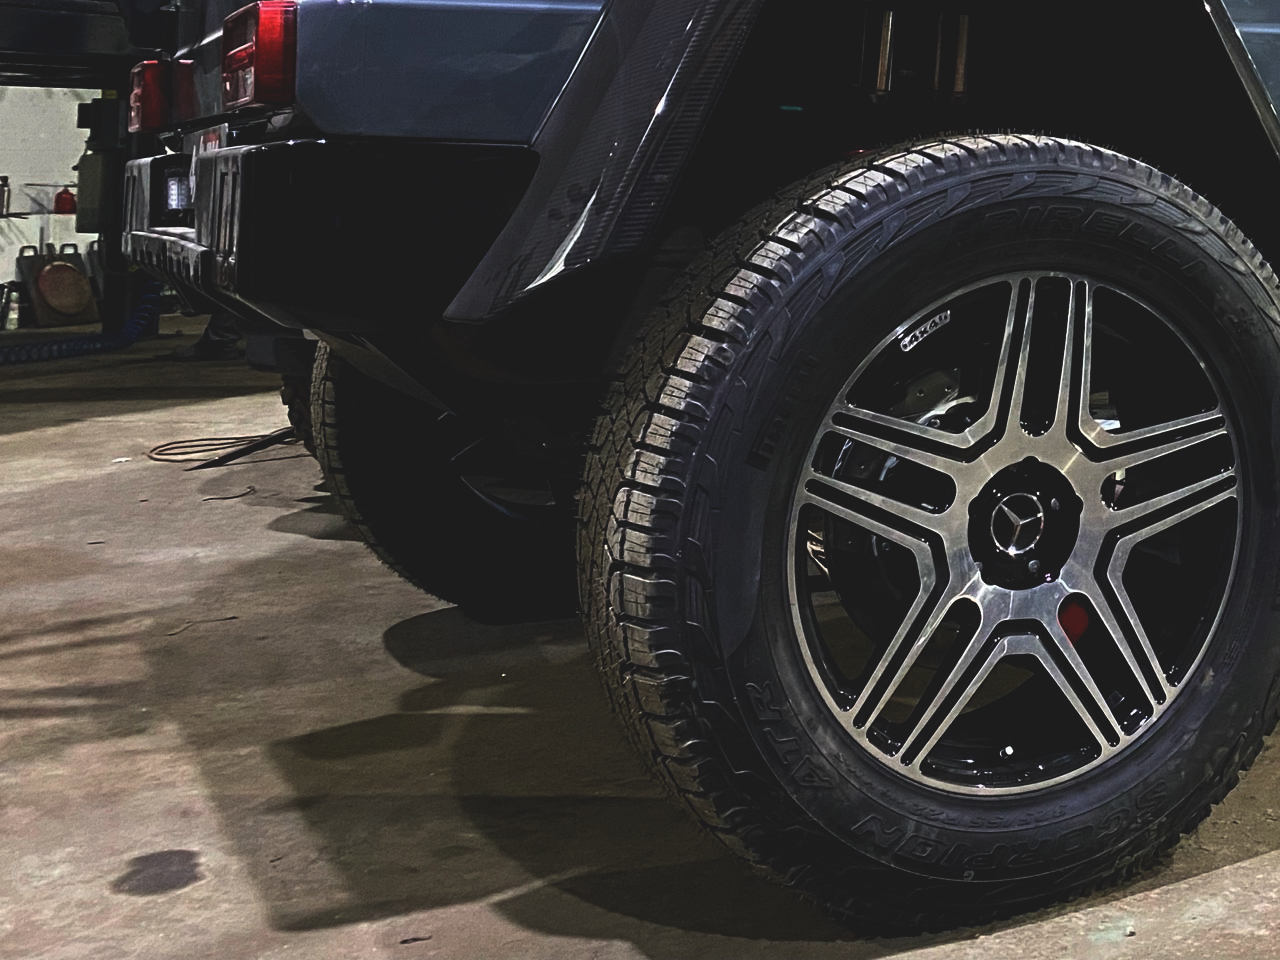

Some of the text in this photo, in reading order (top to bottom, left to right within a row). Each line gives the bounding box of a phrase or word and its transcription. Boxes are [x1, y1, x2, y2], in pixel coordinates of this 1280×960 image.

[979, 204, 1210, 277] PIRELLI
[745, 680, 1169, 871] SCORPION ATR
